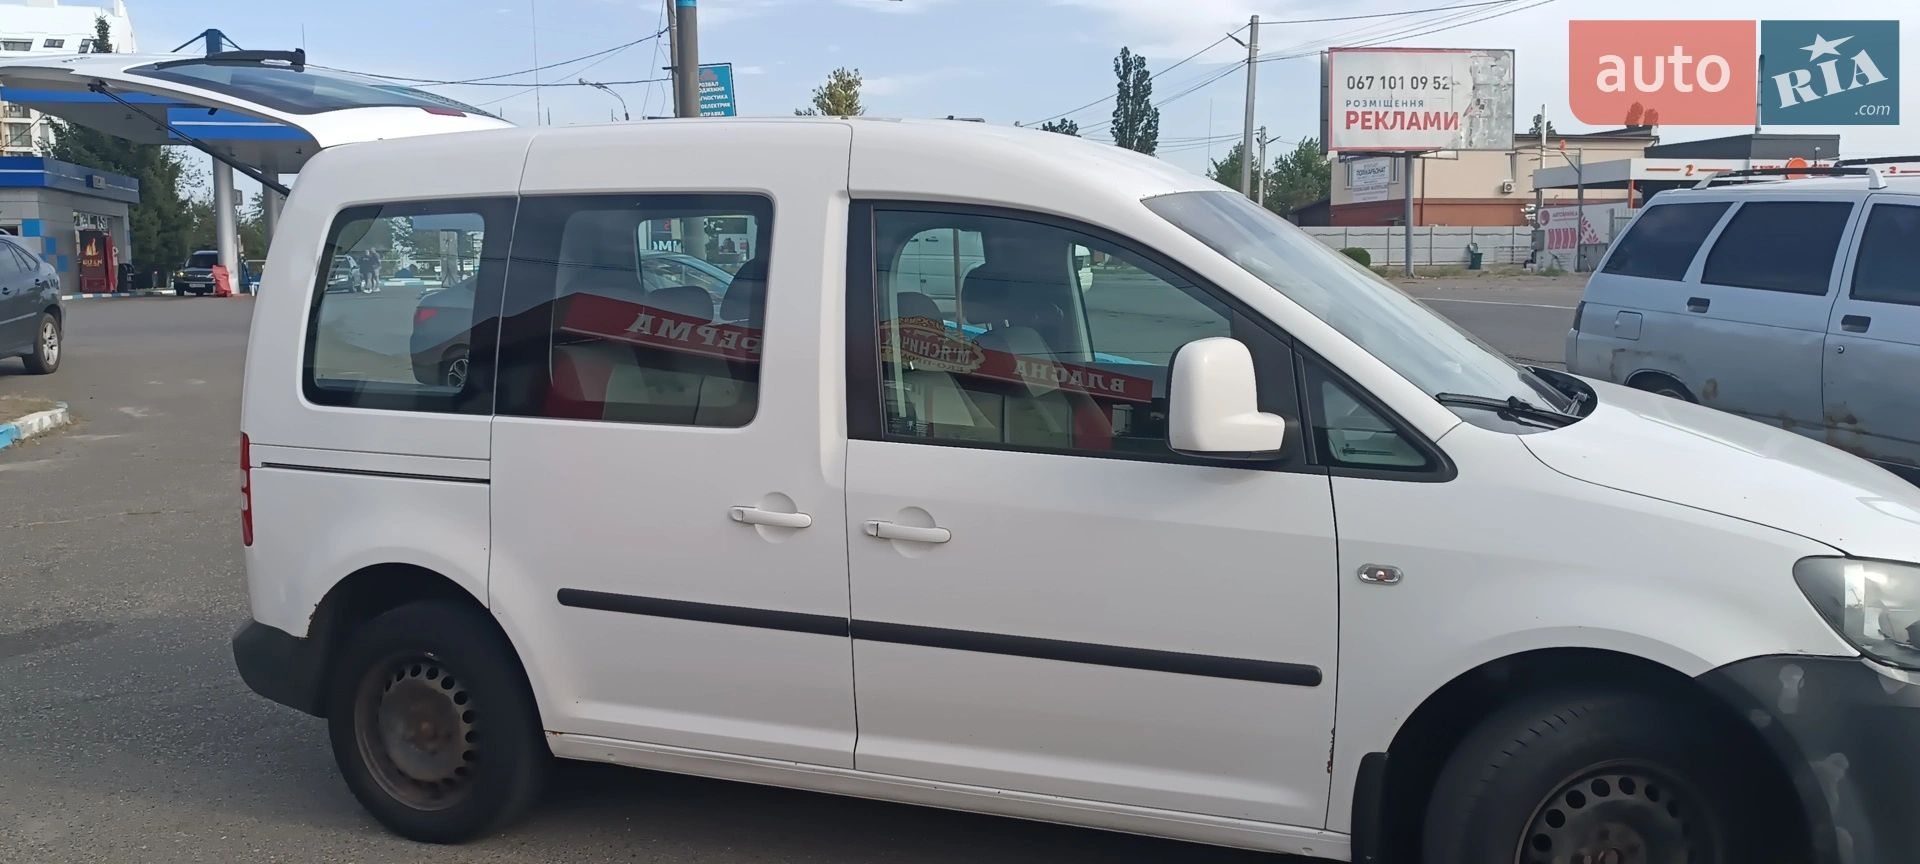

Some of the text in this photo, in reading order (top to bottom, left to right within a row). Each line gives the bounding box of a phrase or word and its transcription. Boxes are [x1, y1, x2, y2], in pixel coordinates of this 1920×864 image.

[1346, 76, 1450, 90] 067 101 09 52
[699, 86, 725, 94] ОДЖЕННЯ
[1345, 100, 1424, 108] РОЗМІЩЕННЯ
[1345, 111, 1460, 131] РЕКЛАМИ
[1685, 164, 1694, 176] 2
